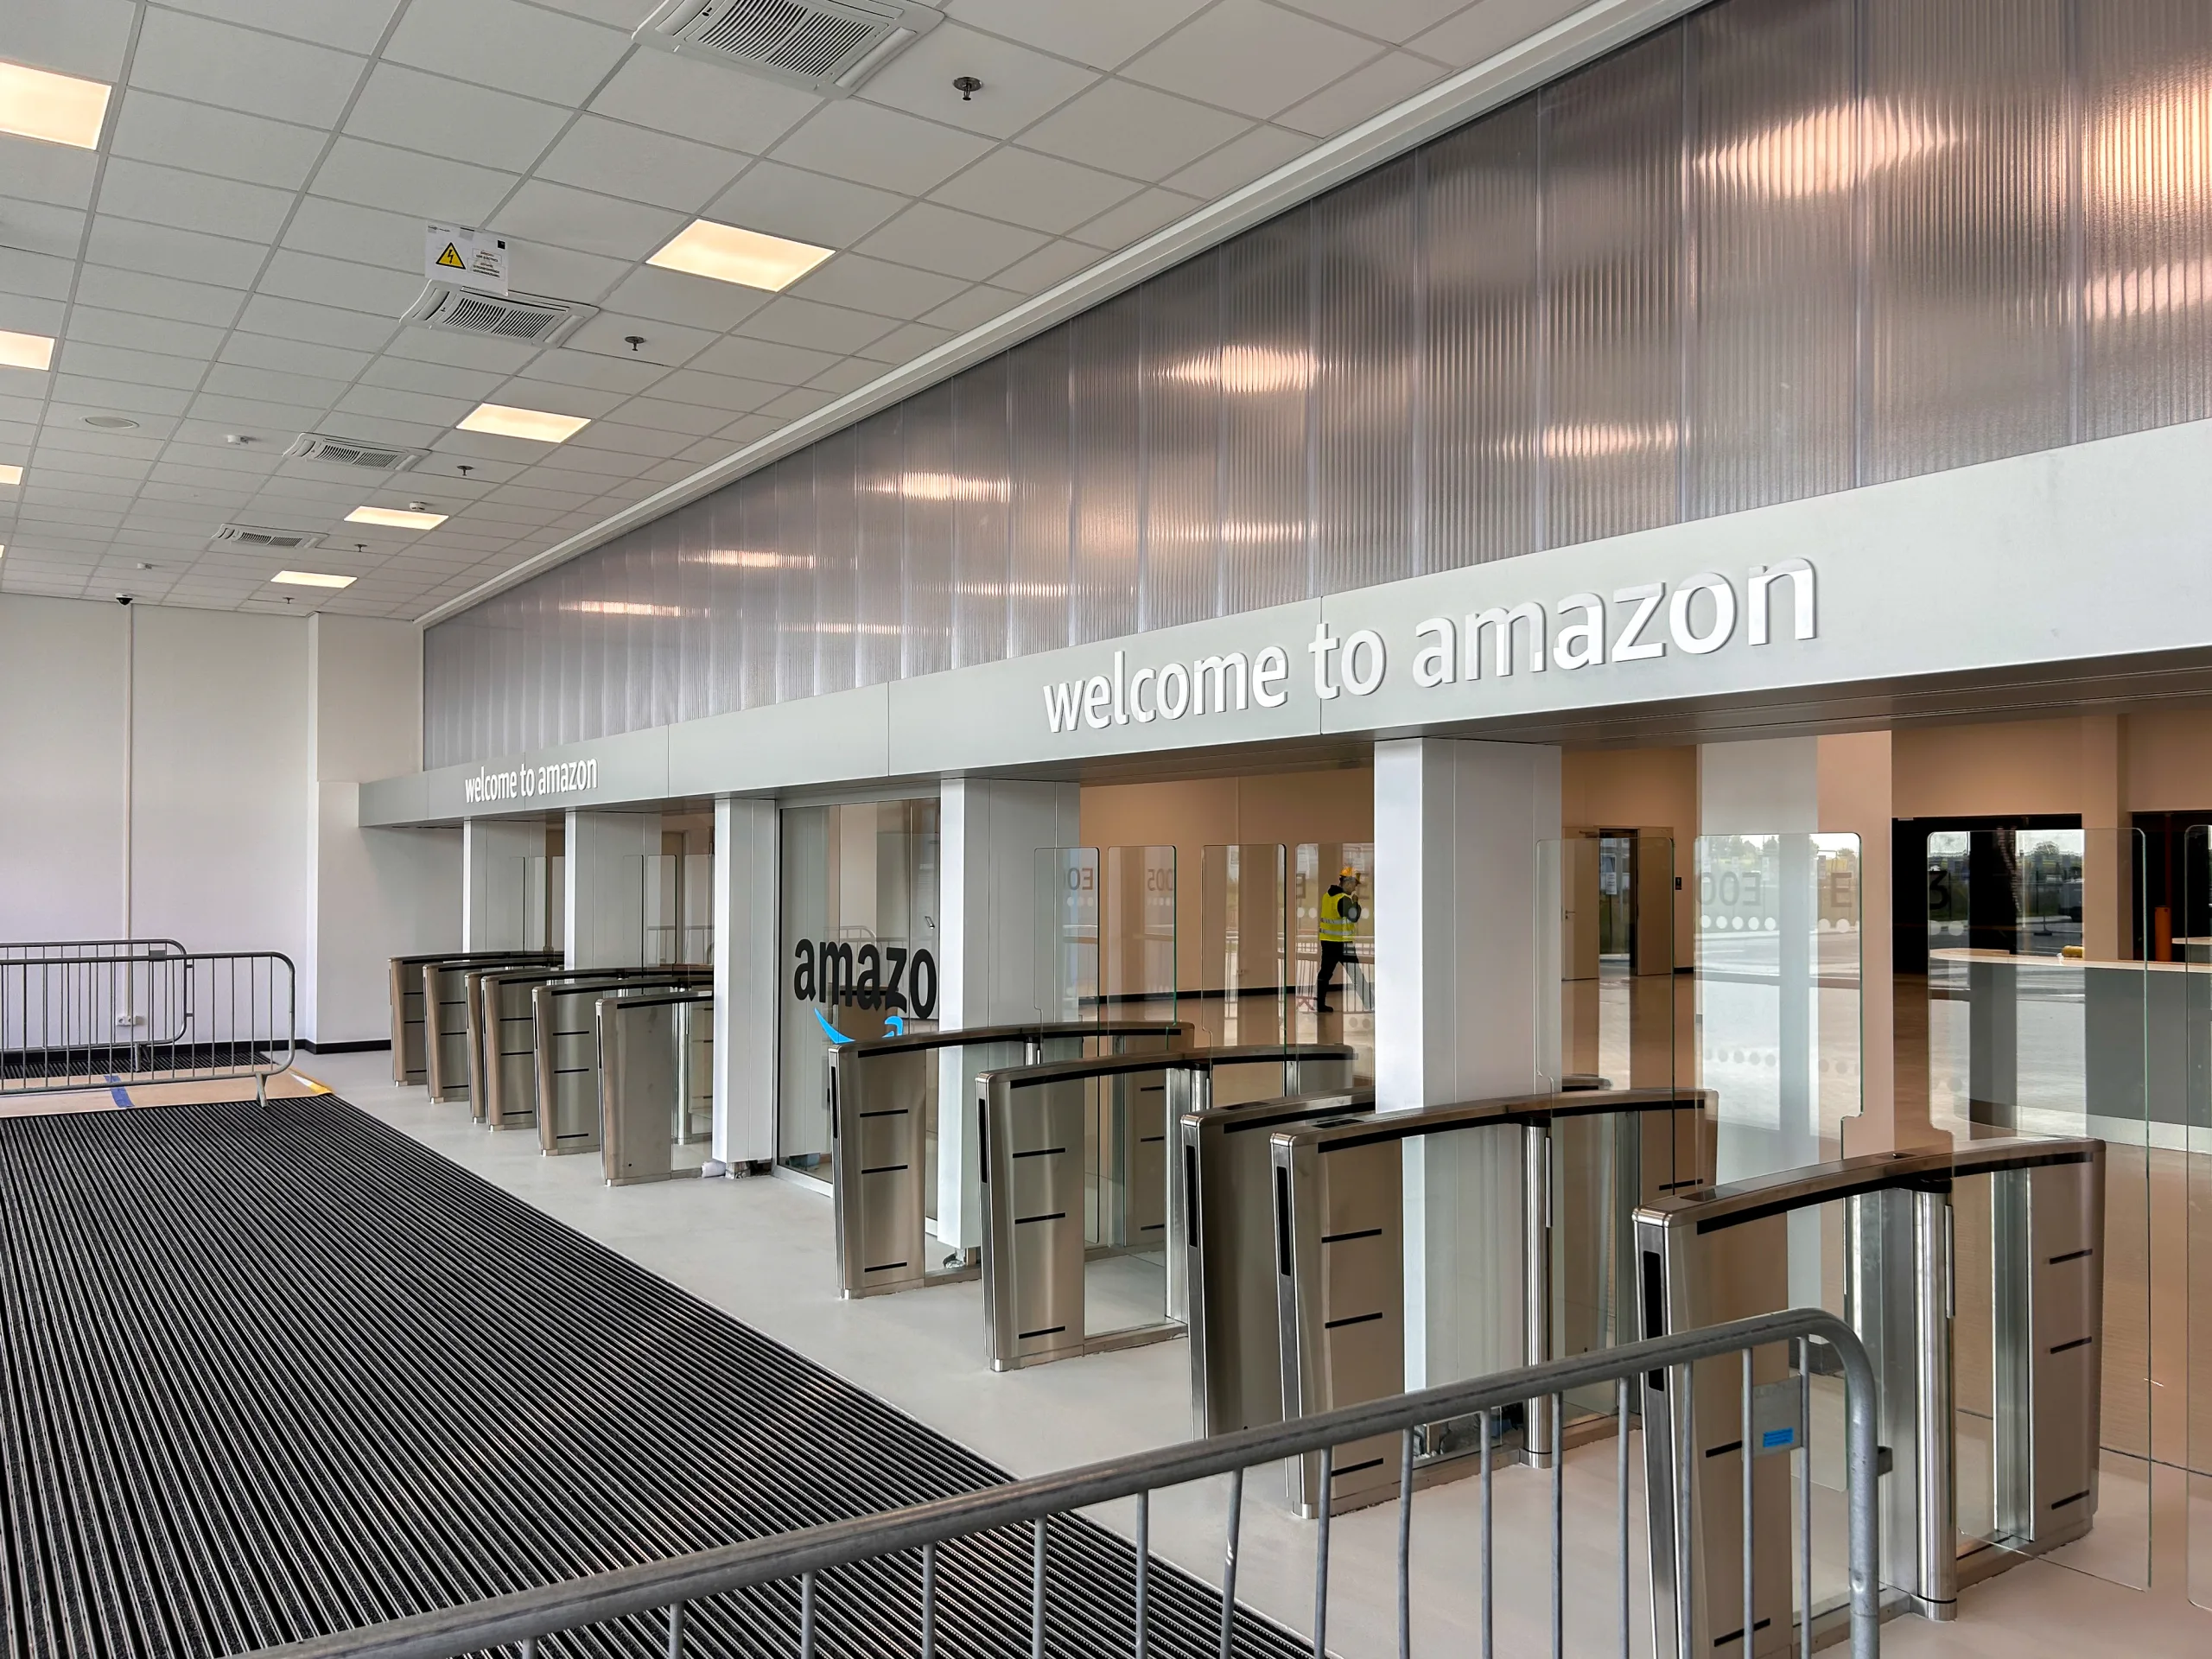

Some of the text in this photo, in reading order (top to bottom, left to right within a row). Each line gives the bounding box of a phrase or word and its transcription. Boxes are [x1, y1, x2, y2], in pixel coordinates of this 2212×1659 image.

[1043, 557, 1817, 733] welcome to amazon
[465, 758, 598, 804] welcome to amazon
